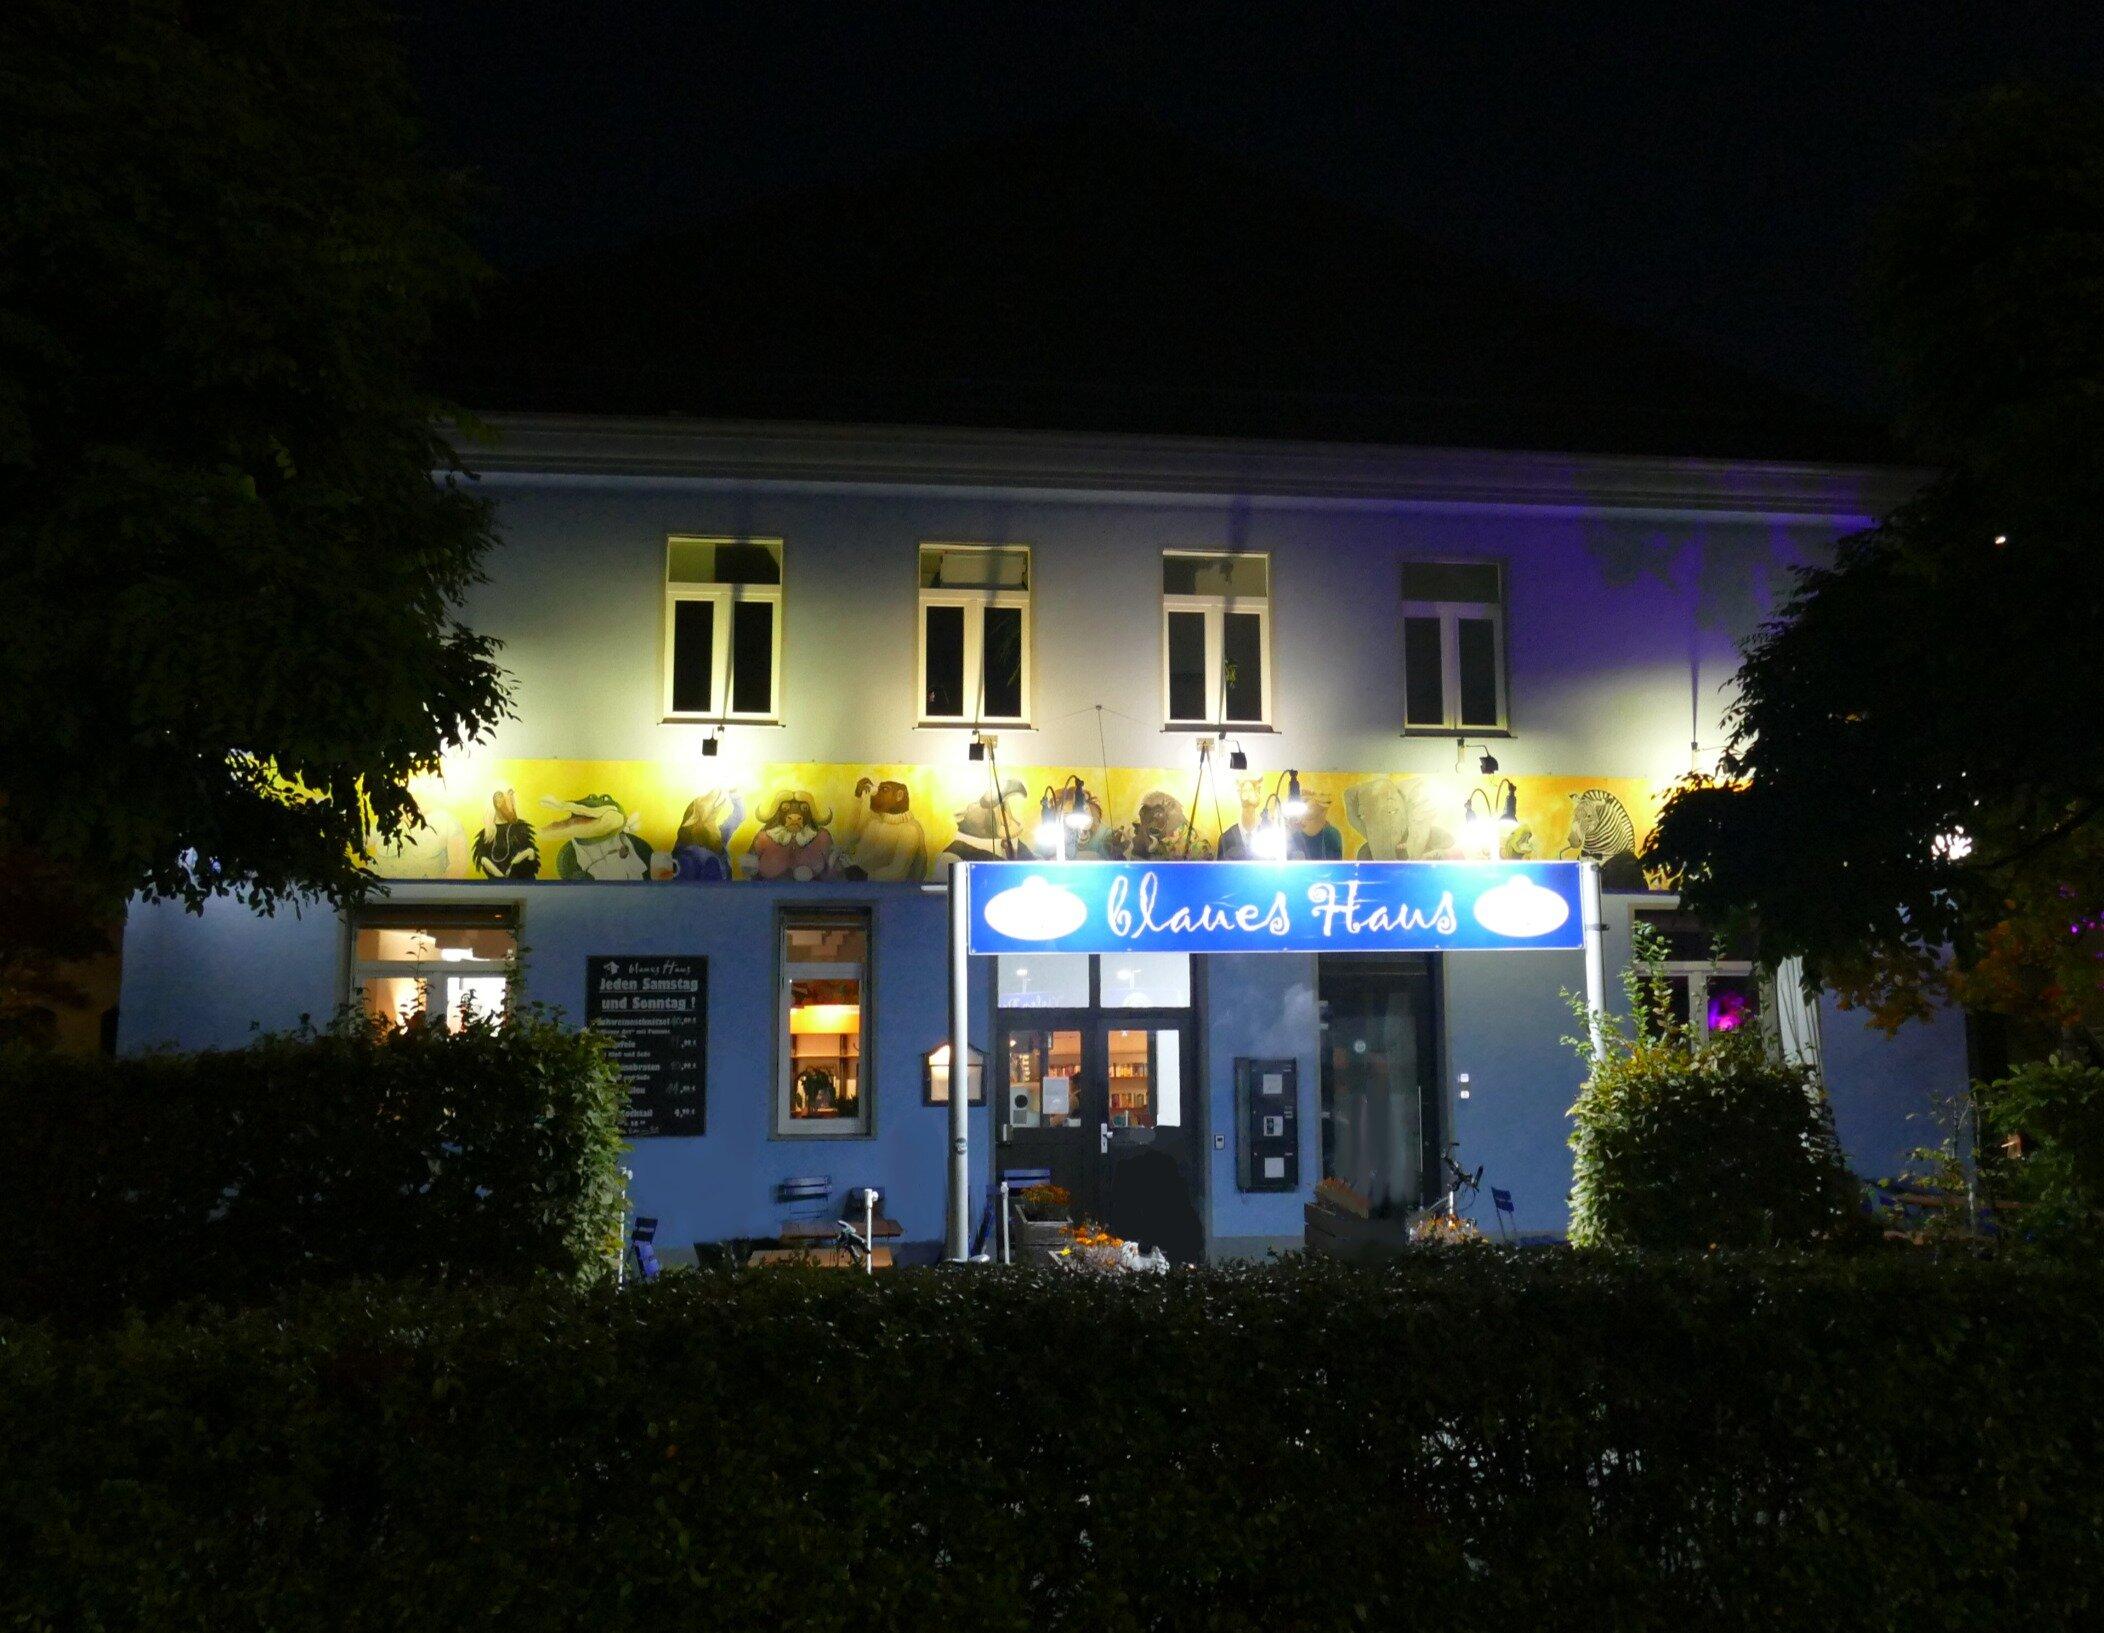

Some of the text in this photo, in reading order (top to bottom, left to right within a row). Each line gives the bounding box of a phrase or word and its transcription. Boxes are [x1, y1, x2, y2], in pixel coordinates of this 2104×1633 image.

[1107, 871, 1457, 938] blaues Haus
[662, 960, 692, 974] Haus
[600, 977, 698, 992] Jeden Samstag
[601, 996, 627, 1010] und
[632, 997, 686, 1011] Sonntag
